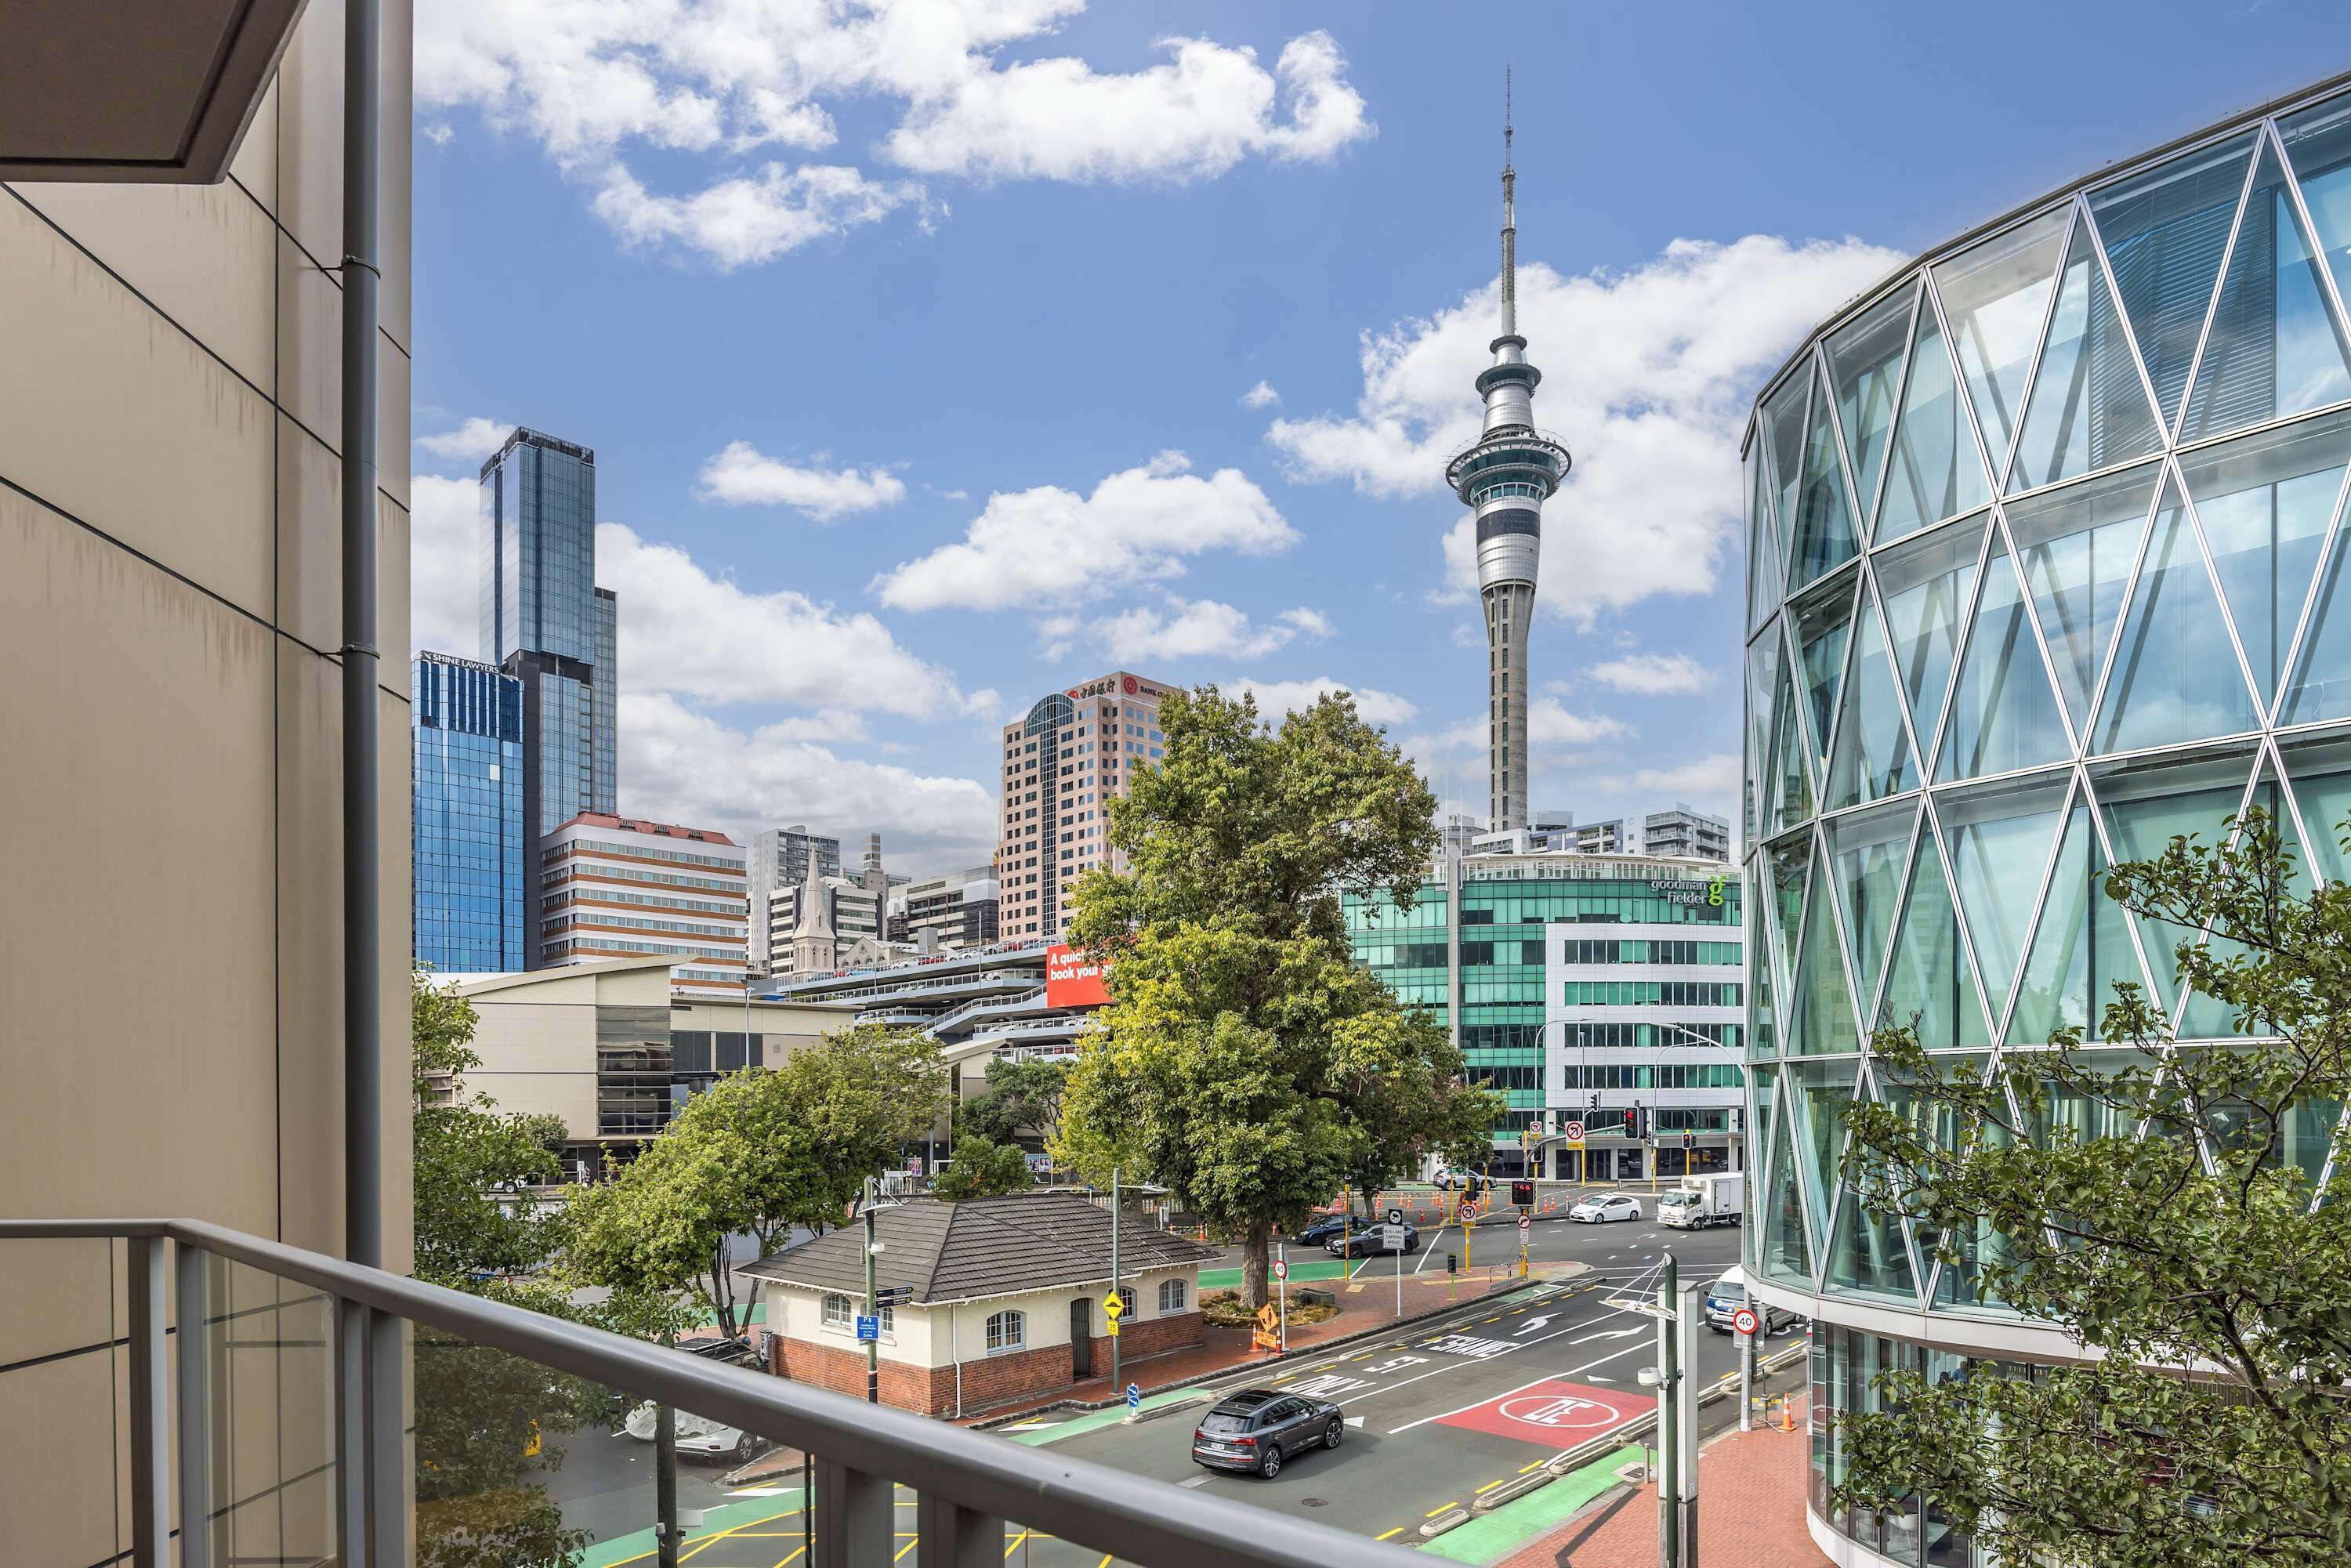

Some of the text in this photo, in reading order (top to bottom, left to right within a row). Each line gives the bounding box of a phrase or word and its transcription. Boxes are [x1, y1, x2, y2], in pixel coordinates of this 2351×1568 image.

[433, 654, 499, 674] SHINE LAWYERS
[1140, 686, 1157, 697] BANK
[1651, 878, 1707, 892] goodman
[1667, 891, 1704, 904] fielder
[1050, 953, 1059, 966] A
[1050, 966, 1075, 981] book
[1076, 965, 1099, 980] your
[1109, 1324, 1117, 1332] 25
[1739, 1317, 1752, 1327] 40
